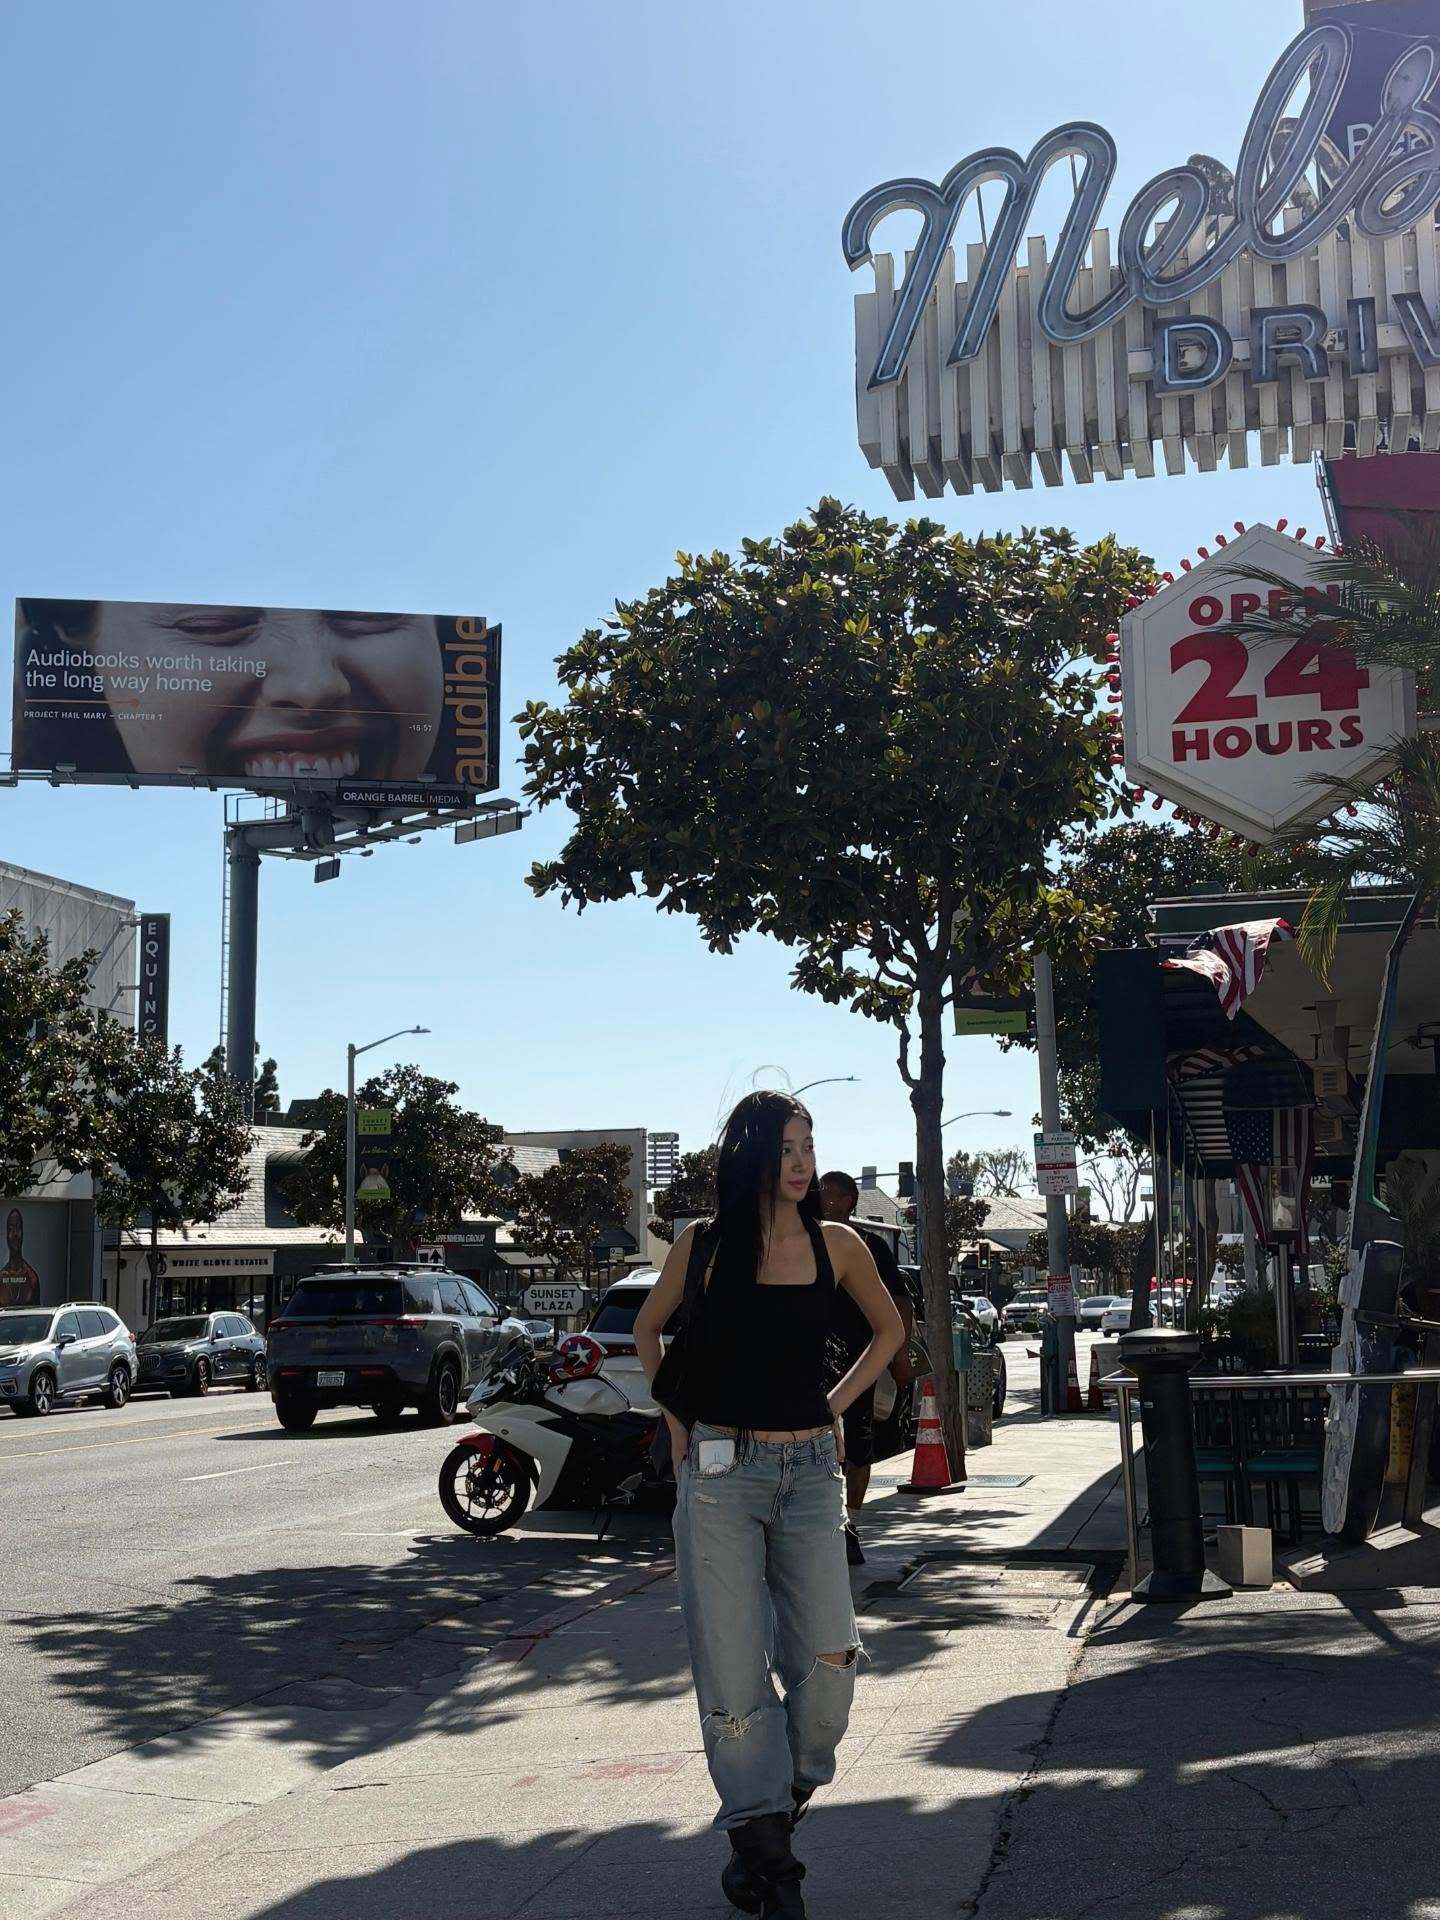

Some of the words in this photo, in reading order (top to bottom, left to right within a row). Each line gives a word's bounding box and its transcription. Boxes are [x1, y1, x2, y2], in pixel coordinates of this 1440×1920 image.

[1188, 585, 1341, 627] OPEN
[26, 649, 140, 668] Audiobooks
[146, 653, 202, 671] worth
[208, 655, 267, 678] taking
[1169, 617, 1370, 724] 24
[25, 671, 57, 688] the
[63, 671, 104, 692] long
[110, 677, 149, 693] way
[156, 674, 212, 692] home
[445, 616, 488, 785] audible
[24, 711, 59, 719] PROJECT
[62, 711, 81, 719] HAIL
[84, 712, 107, 720] MARY
[118, 713, 156, 721] CHAPTER
[1171, 715, 1364, 762] HOURS
[342, 791, 386, 803] ORANGE
[388, 792, 425, 803] BARREL
[429, 794, 461, 805] MEDIA
[234, 1258, 269, 1266] ESTATES
[530, 1289, 576, 1299] SUNSET
[534, 1301, 573, 1311] PLAZA
